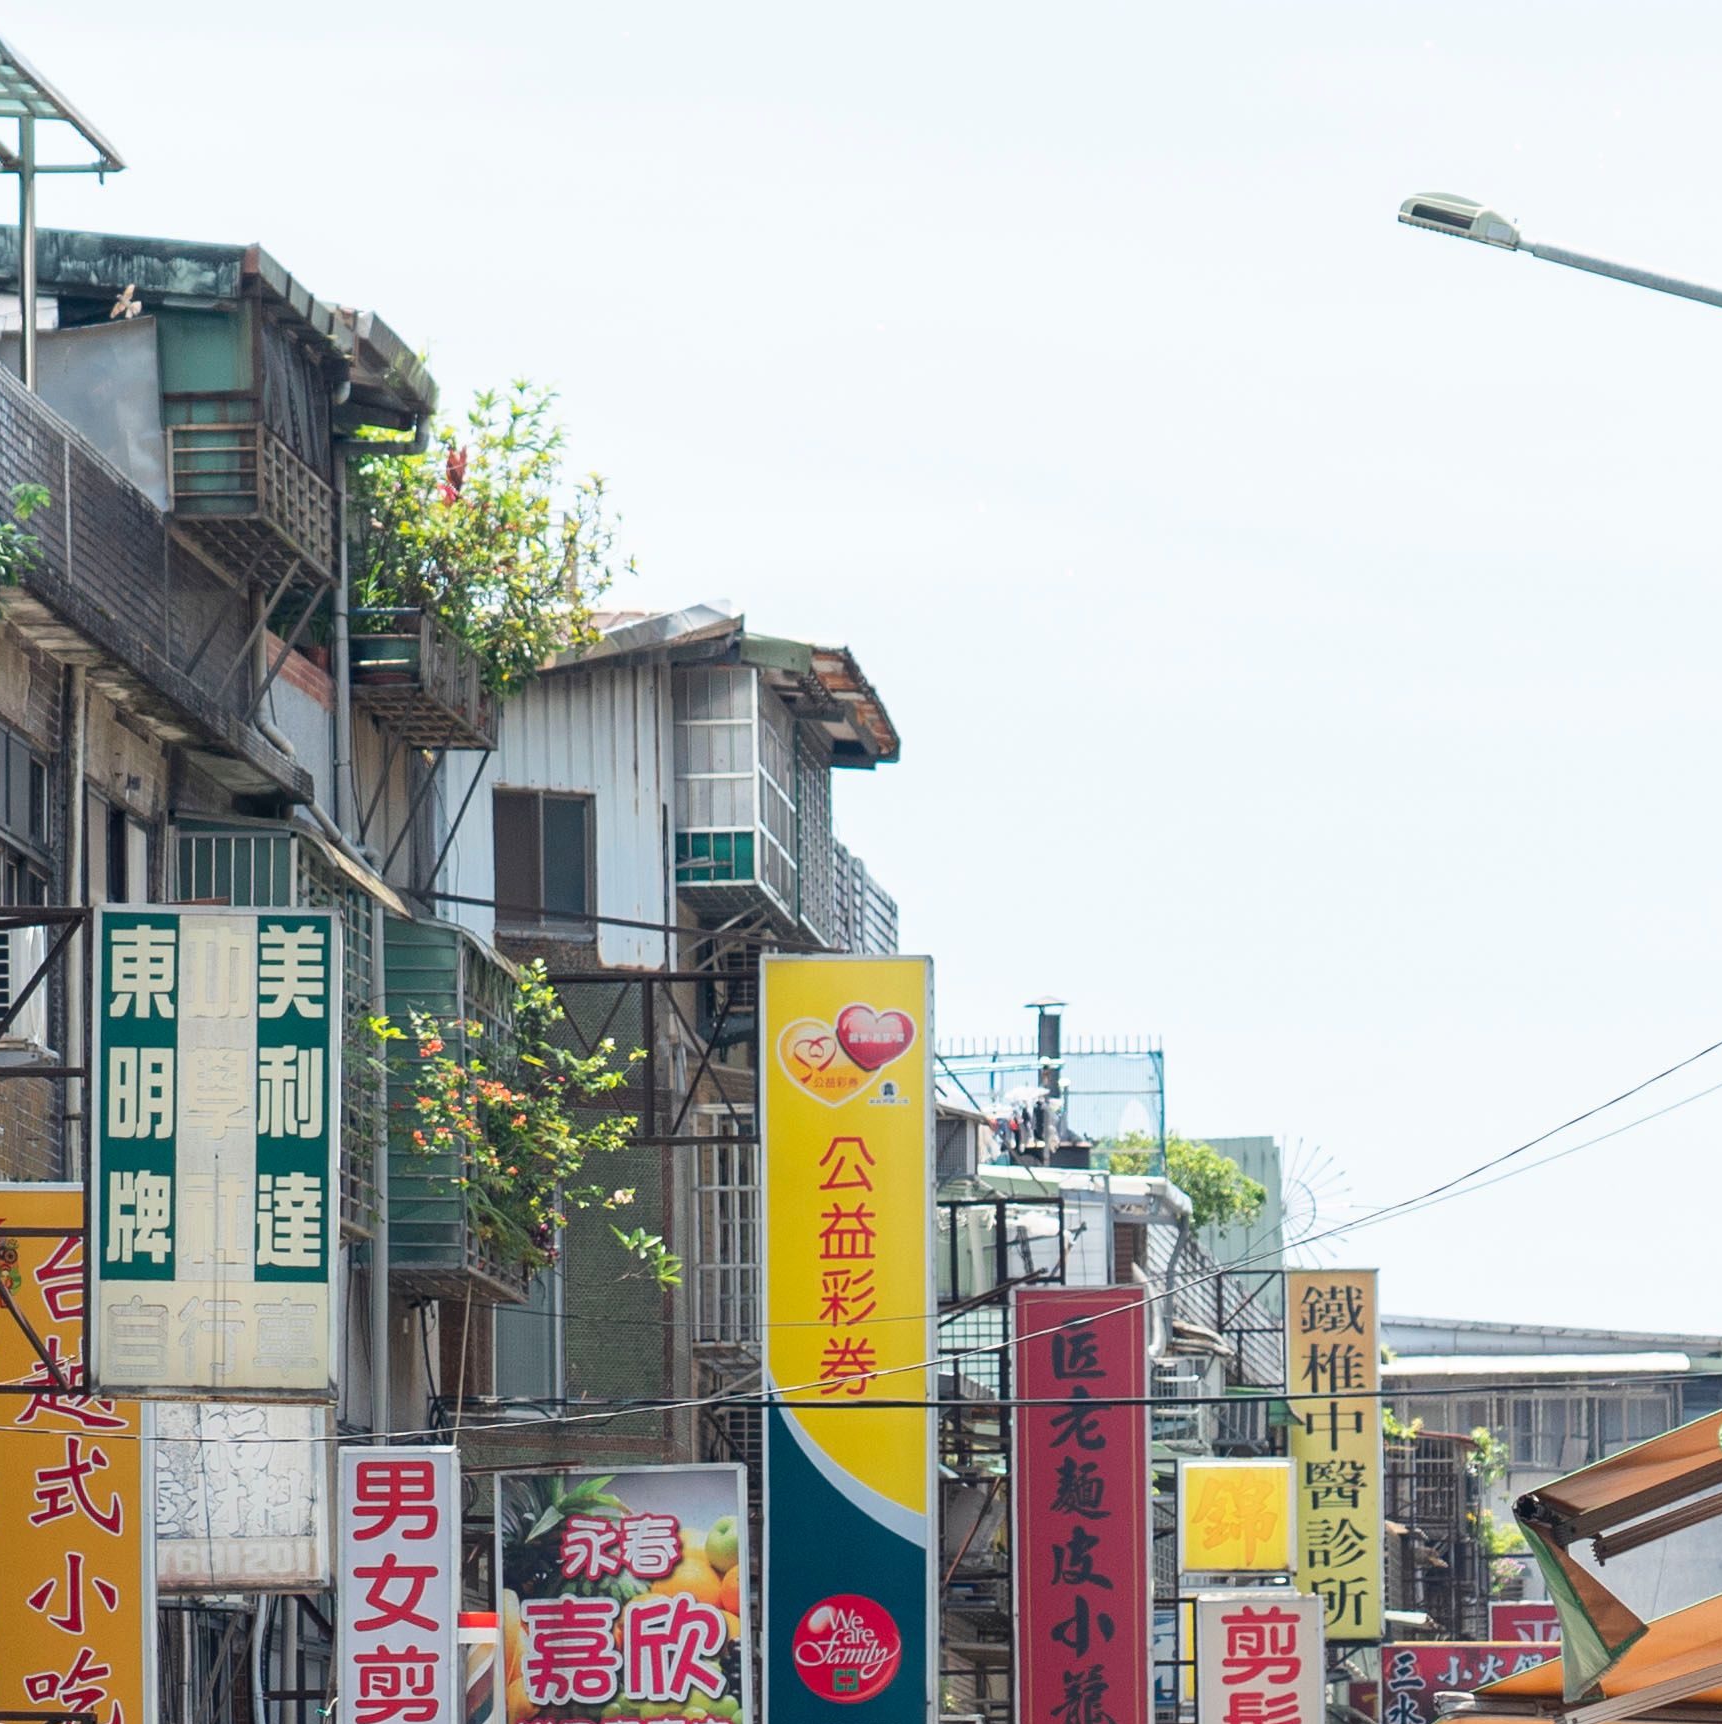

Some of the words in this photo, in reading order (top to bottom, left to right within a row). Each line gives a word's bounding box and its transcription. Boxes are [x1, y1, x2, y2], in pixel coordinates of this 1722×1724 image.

[107, 924, 176, 1266] 東明牌
[256, 924, 326, 1270] 美利達
[818, 1134, 878, 1397] 公益彩券
[521, 1592, 729, 1706] 嘉欣
[560, 1513, 680, 1579] 永春
